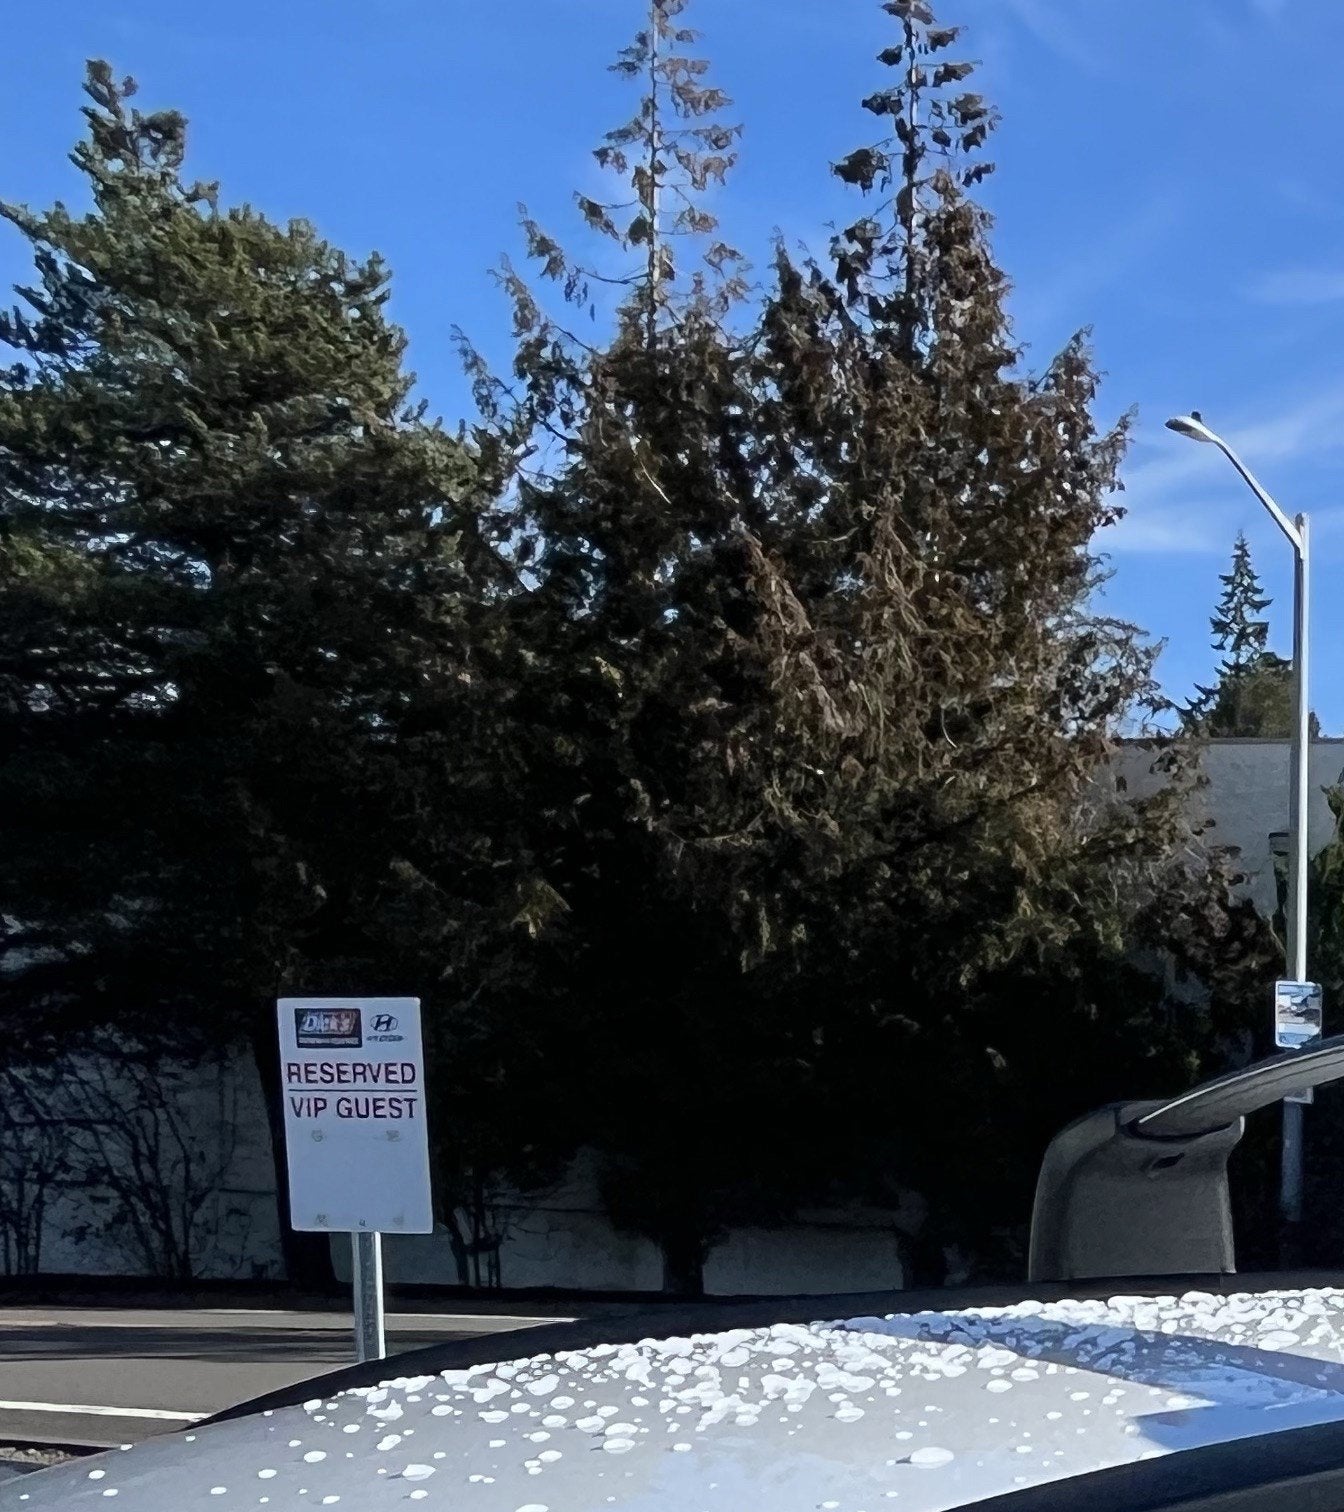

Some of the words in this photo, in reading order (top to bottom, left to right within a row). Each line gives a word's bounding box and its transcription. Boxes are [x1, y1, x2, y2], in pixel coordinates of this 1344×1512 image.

[287, 1061, 416, 1085] RESERVED
[290, 1096, 328, 1119] VIP
[336, 1096, 418, 1119] GUEST
